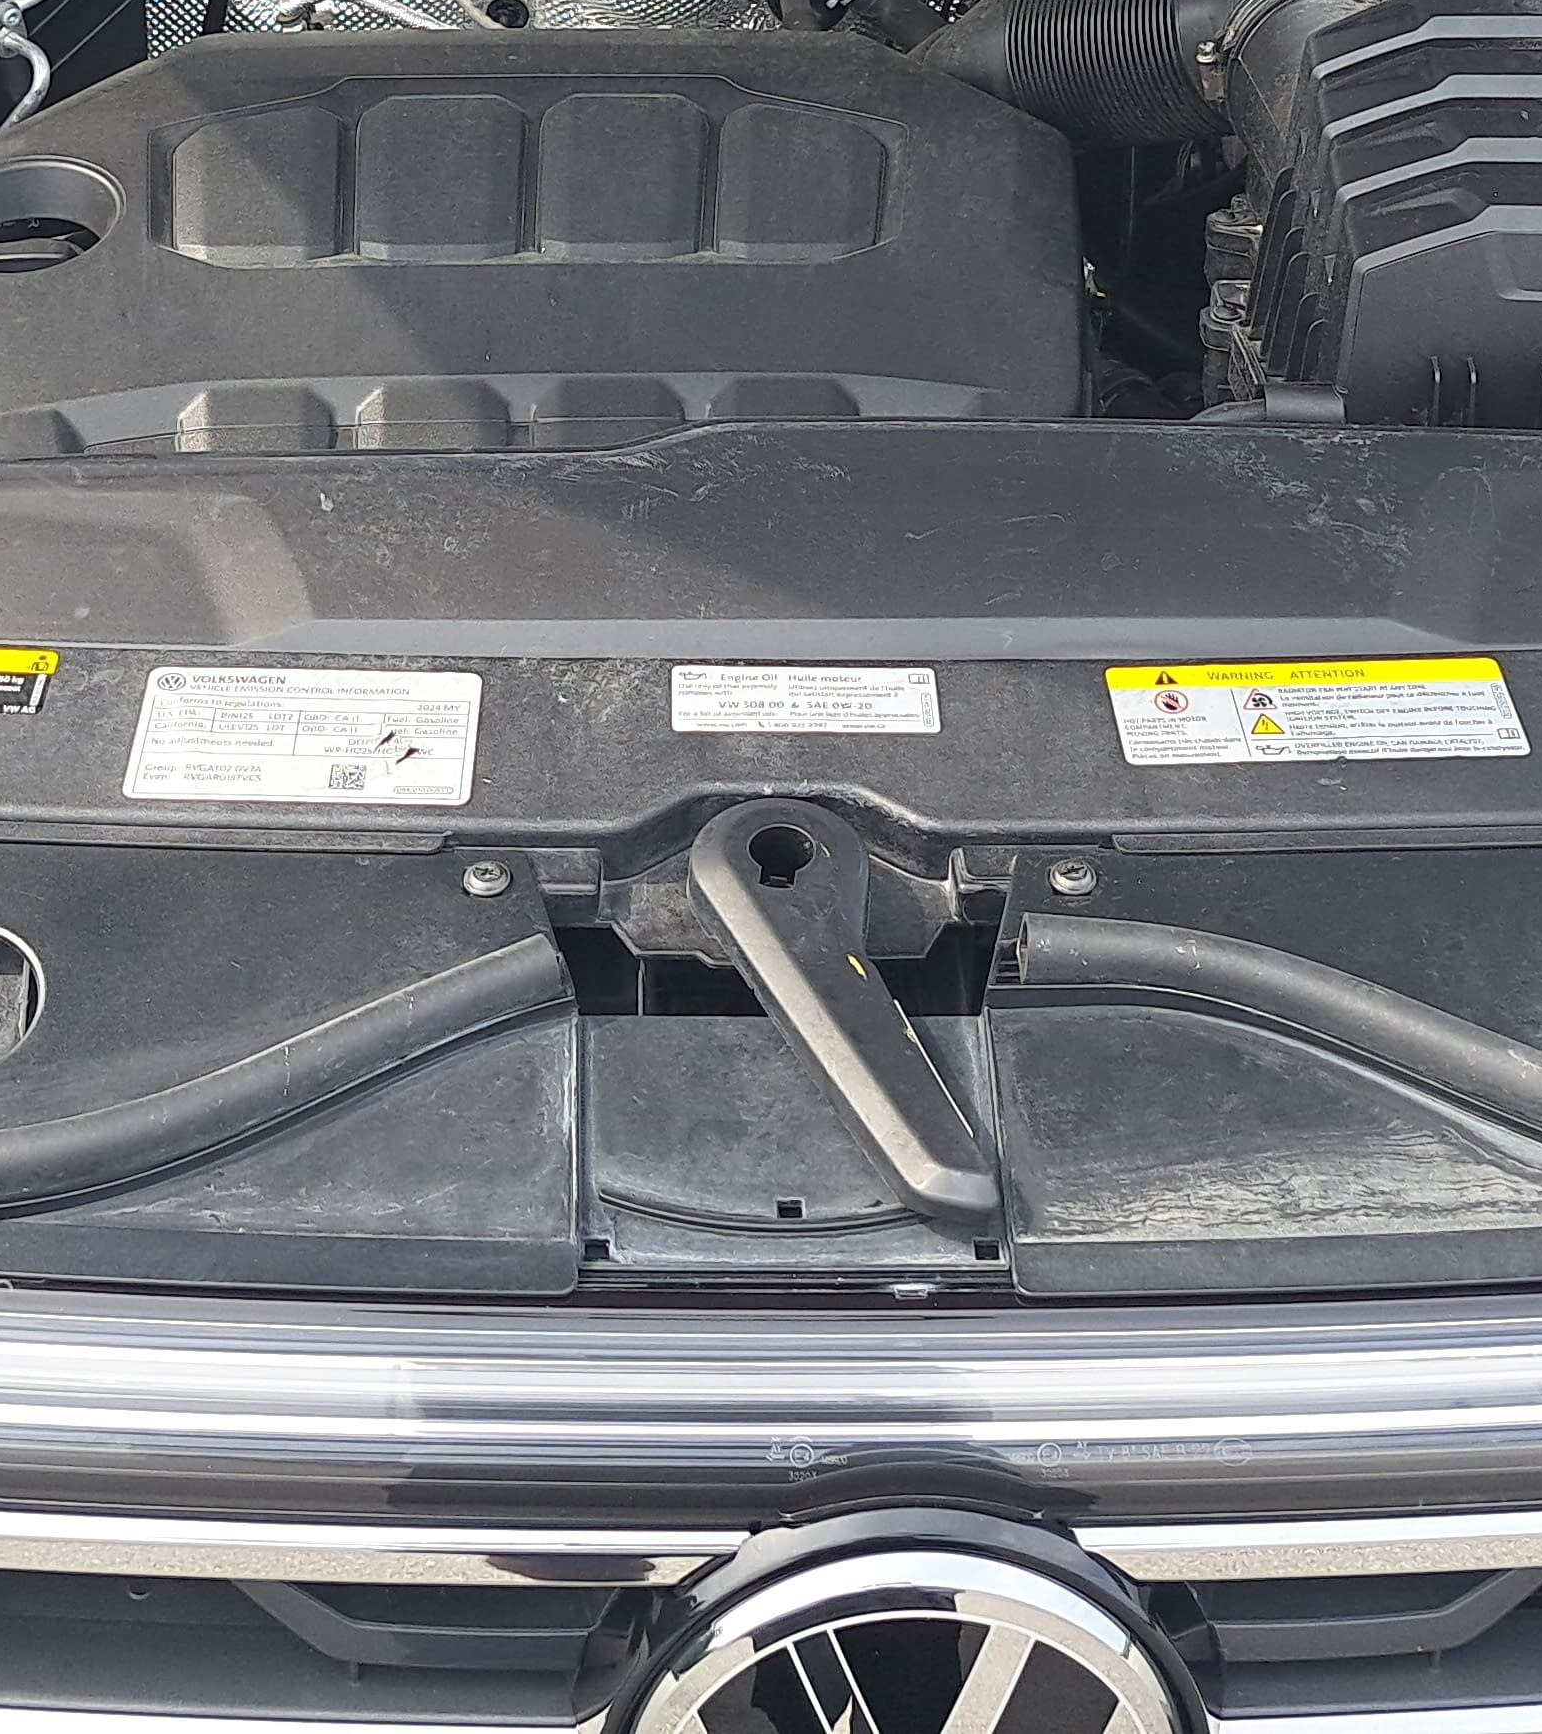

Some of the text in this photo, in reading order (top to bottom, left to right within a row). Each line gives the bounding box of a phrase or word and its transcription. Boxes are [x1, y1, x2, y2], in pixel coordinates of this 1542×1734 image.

[720, 673, 778, 683] Engine Oil
[788, 674, 862, 683] Huile moteur
[1207, 668, 1366, 681] WARNING ATTENTION
[192, 675, 287, 685] VOLKSWAGEN
[234, 685, 284, 694] EMISSION
[286, 686, 335, 695] CONTROL
[337, 687, 410, 696] INFORMATION
[3, 704, 20, 713] VW
[416, 703, 461, 712] 2024 MY
[718, 701, 740, 709] VW
[768, 701, 785, 709] 00
[806, 701, 828, 710] SAE
[415, 716, 460, 724] Gasoline
[413, 727, 459, 735] Gasoline
